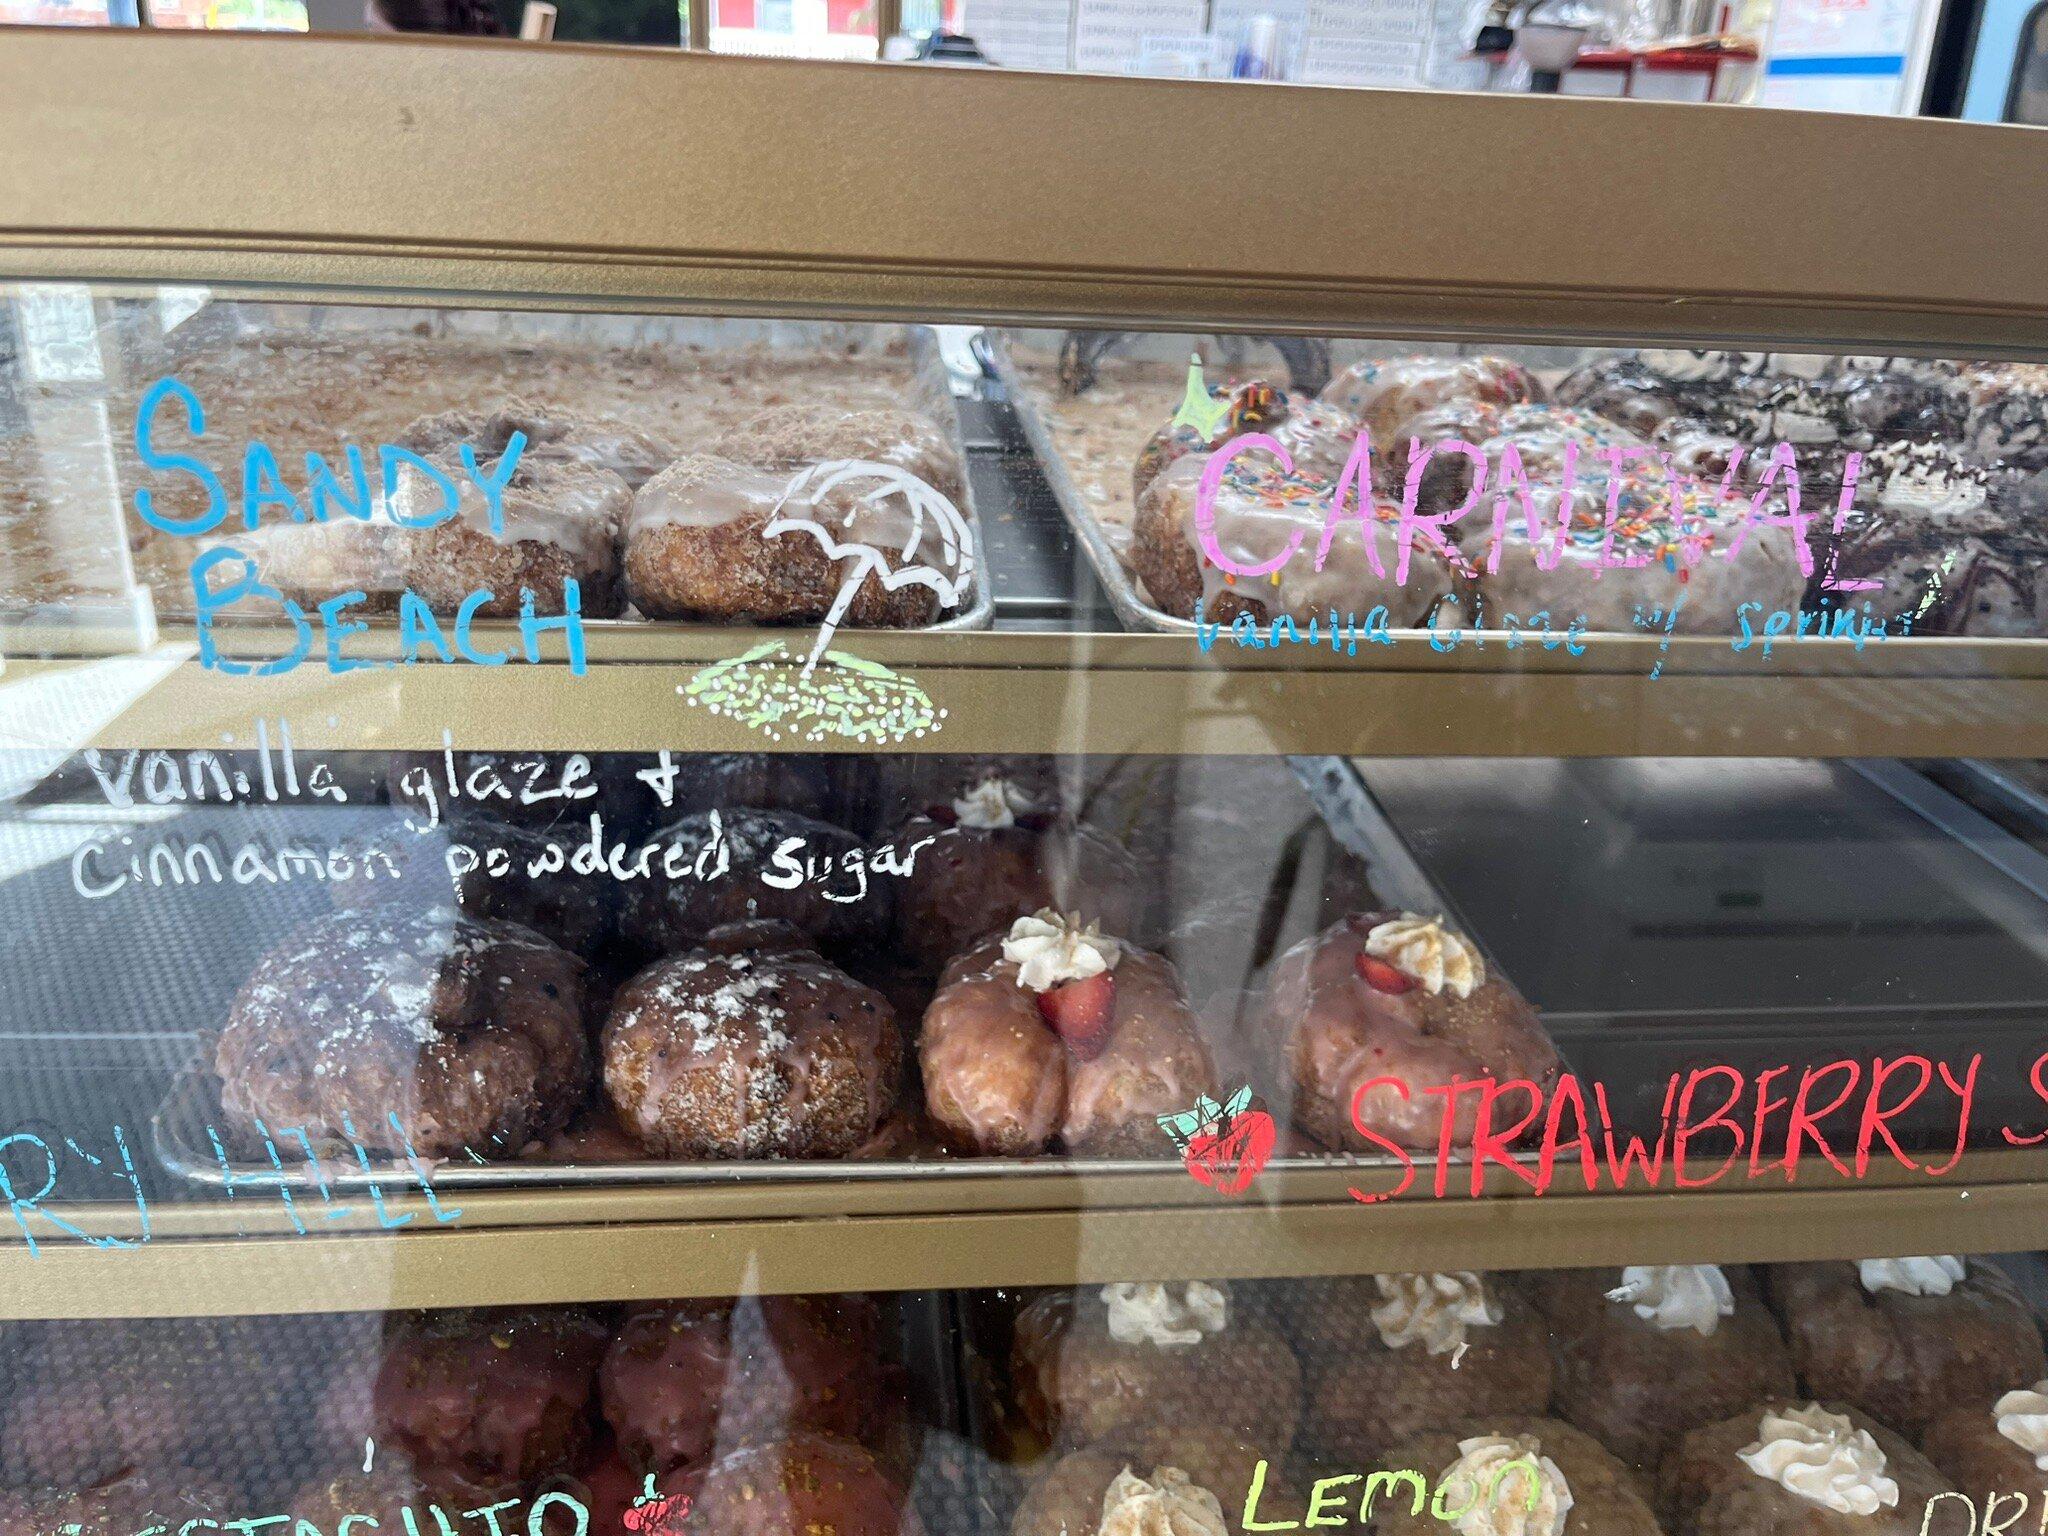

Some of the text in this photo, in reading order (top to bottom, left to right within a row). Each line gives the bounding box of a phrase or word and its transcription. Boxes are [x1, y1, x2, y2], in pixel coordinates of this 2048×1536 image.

[136, 377, 528, 537] SANDY
[1195, 429, 1885, 591] CARNIVAL
[190, 546, 588, 676] BEACH
[401, 727, 598, 834] glaze
[445, 808, 731, 903] powdered
[1348, 1053, 1982, 1204] STRAWBERRY
